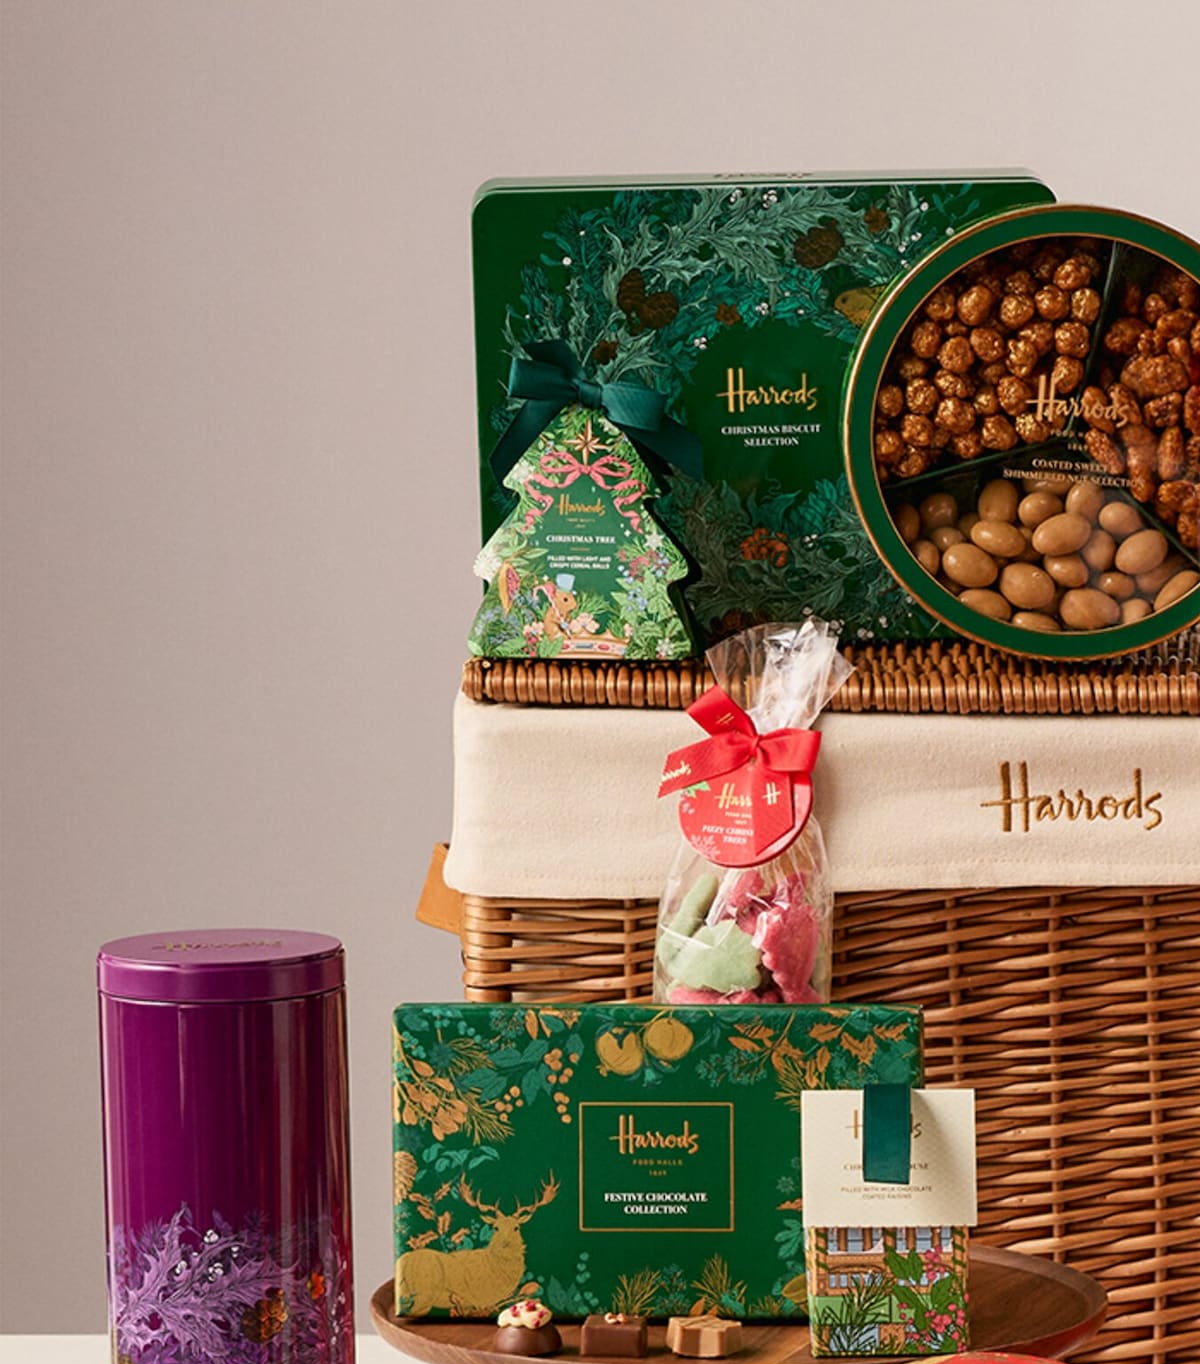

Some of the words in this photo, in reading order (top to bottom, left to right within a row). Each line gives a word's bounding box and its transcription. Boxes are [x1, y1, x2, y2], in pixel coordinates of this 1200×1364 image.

[716, 367, 818, 413] Harrods
[1026, 375, 1130, 428] Harrods
[720, 424, 780, 436] CHRISTMAS
[781, 423, 821, 434] BISCUIT
[743, 436, 799, 447] SELECTION
[1032, 458, 1073, 470] COATED
[1003, 469, 1066, 482] SHIMMERED
[1091, 475, 1146, 488] SELECTION
[555, 493, 606, 517] Harrods
[546, 535, 594, 543] CHRISTMAS
[595, 536, 616, 544] TREE
[979, 760, 1163, 834] Harrods
[702, 824, 724, 834] FIZZY
[723, 836, 747, 845] TREES
[609, 1114, 699, 1154] Harrods
[603, 1192, 645, 1202] FESTIVE
[645, 1192, 708, 1202] CHOCOLATE
[623, 1205, 689, 1214] COLLECTION
